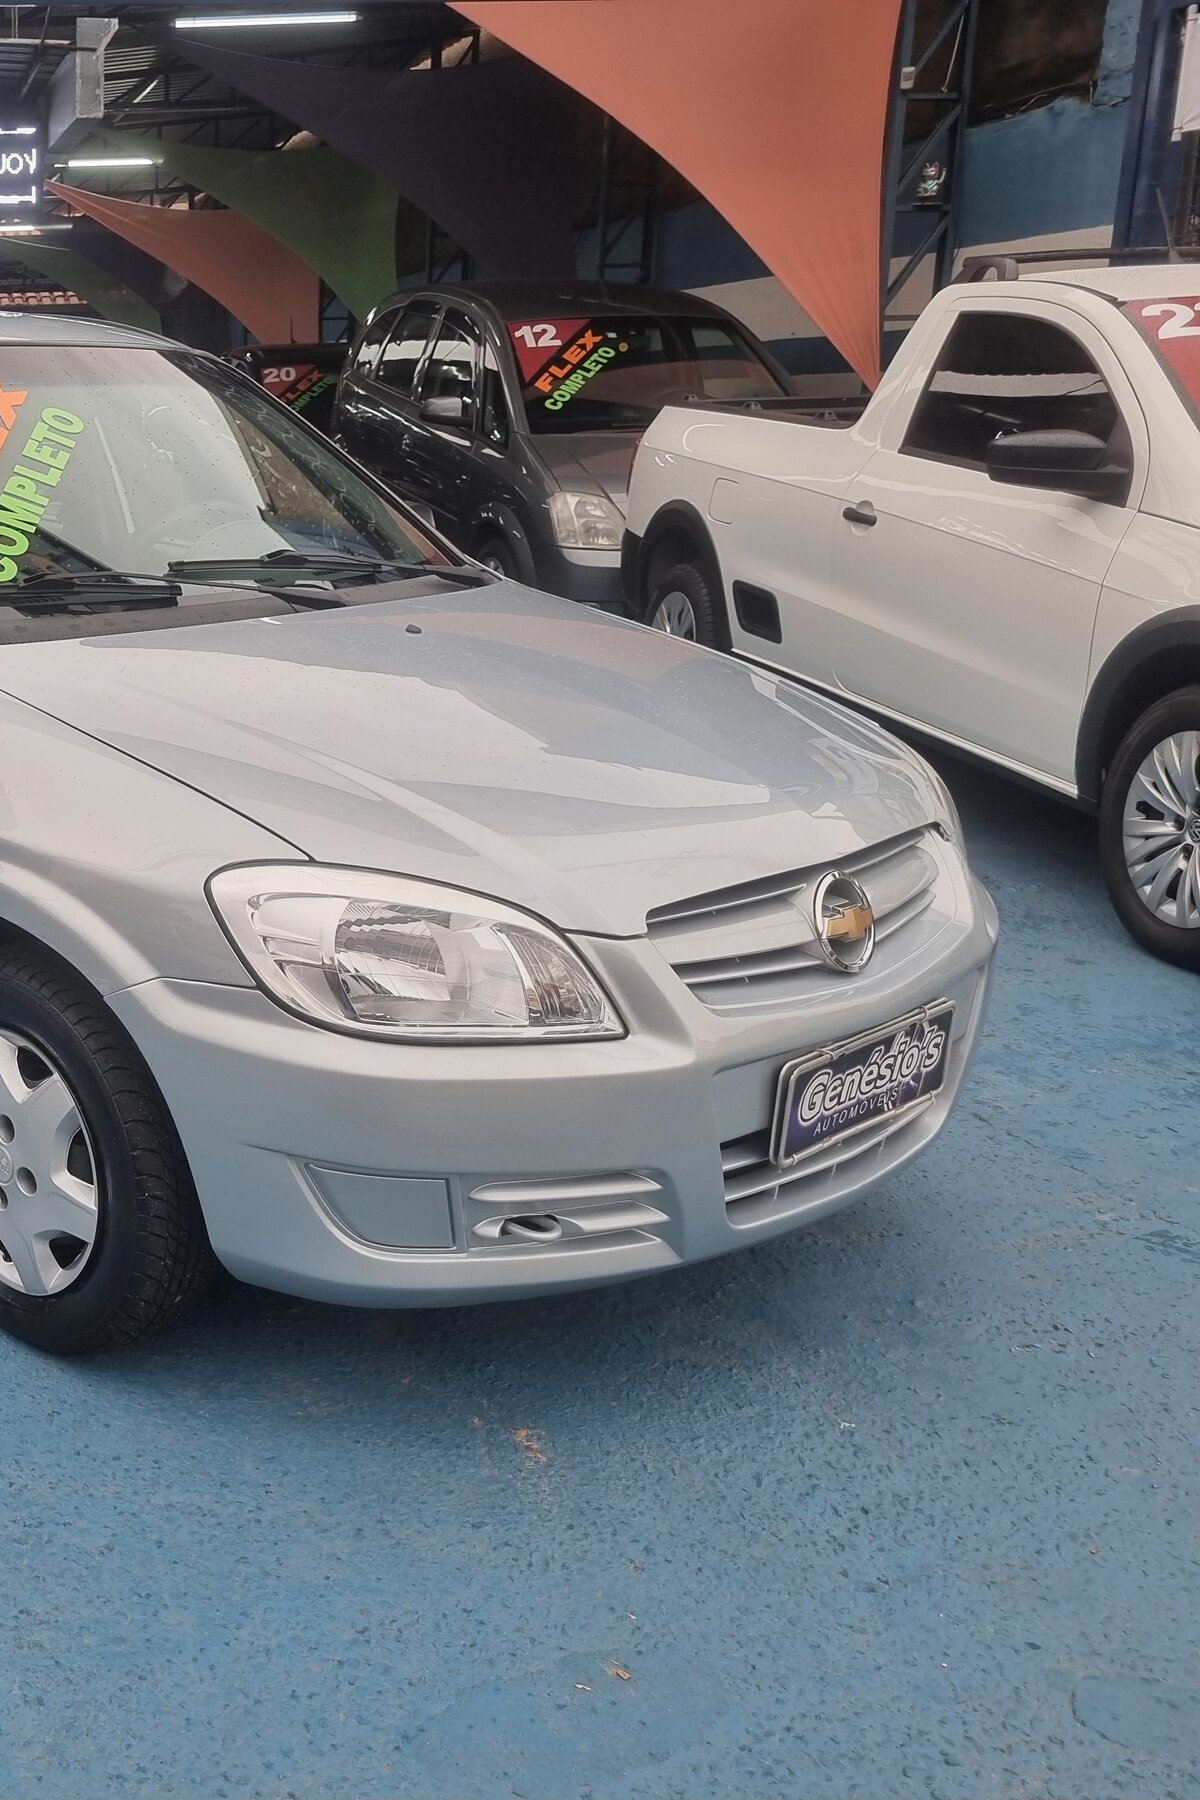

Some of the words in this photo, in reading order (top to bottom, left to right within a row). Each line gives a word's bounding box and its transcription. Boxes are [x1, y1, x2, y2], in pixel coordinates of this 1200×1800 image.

[514, 323, 562, 348] 12
[1141, 303, 1200, 340] 2
[263, 367, 296, 384] 20
[534, 329, 603, 393] FLEX
[544, 346, 616, 411] COMPLETO
[799, 1027, 945, 1125] Genésio's
